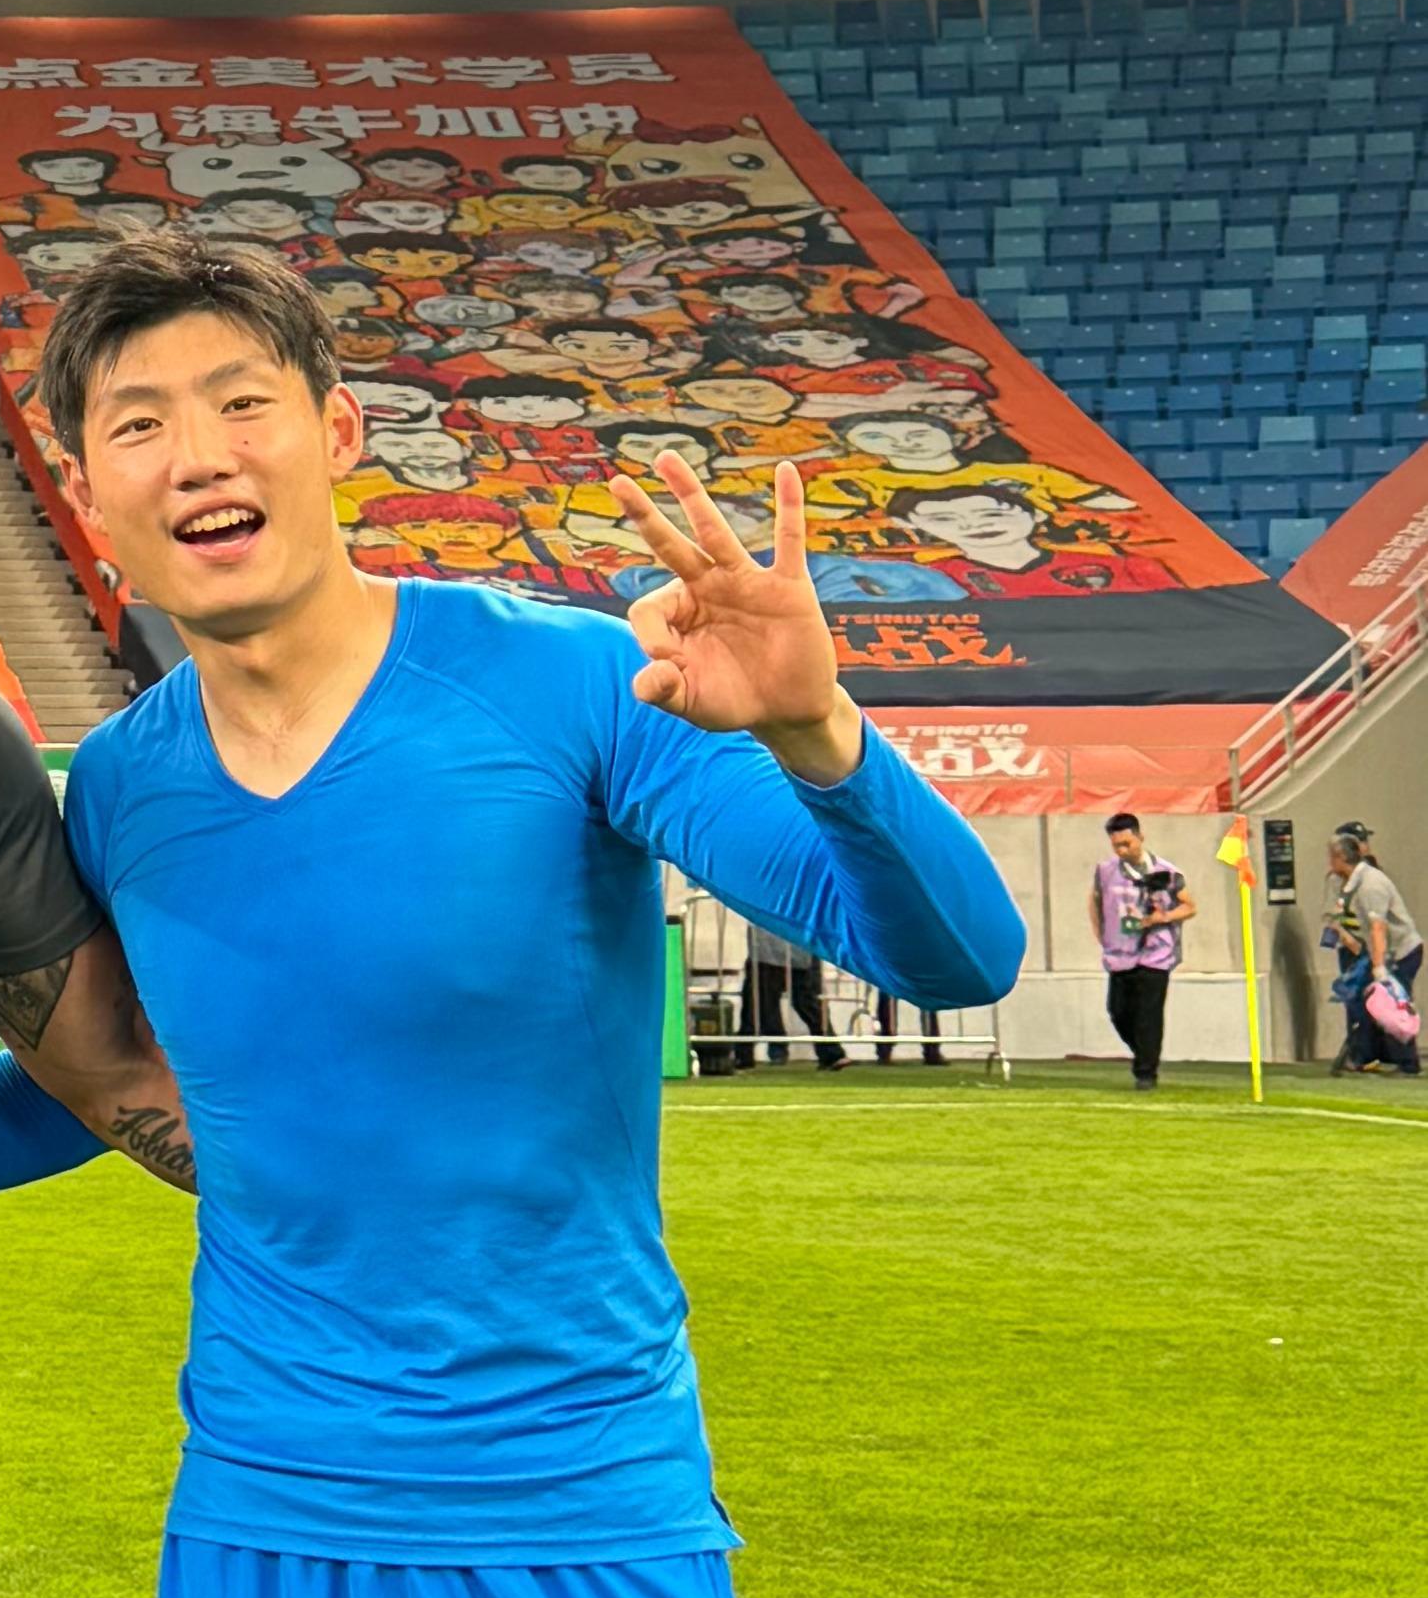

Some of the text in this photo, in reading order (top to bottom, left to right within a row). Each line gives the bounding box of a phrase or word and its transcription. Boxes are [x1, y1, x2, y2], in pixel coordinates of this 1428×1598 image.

[55, 103, 640, 139] 为海牛加油
